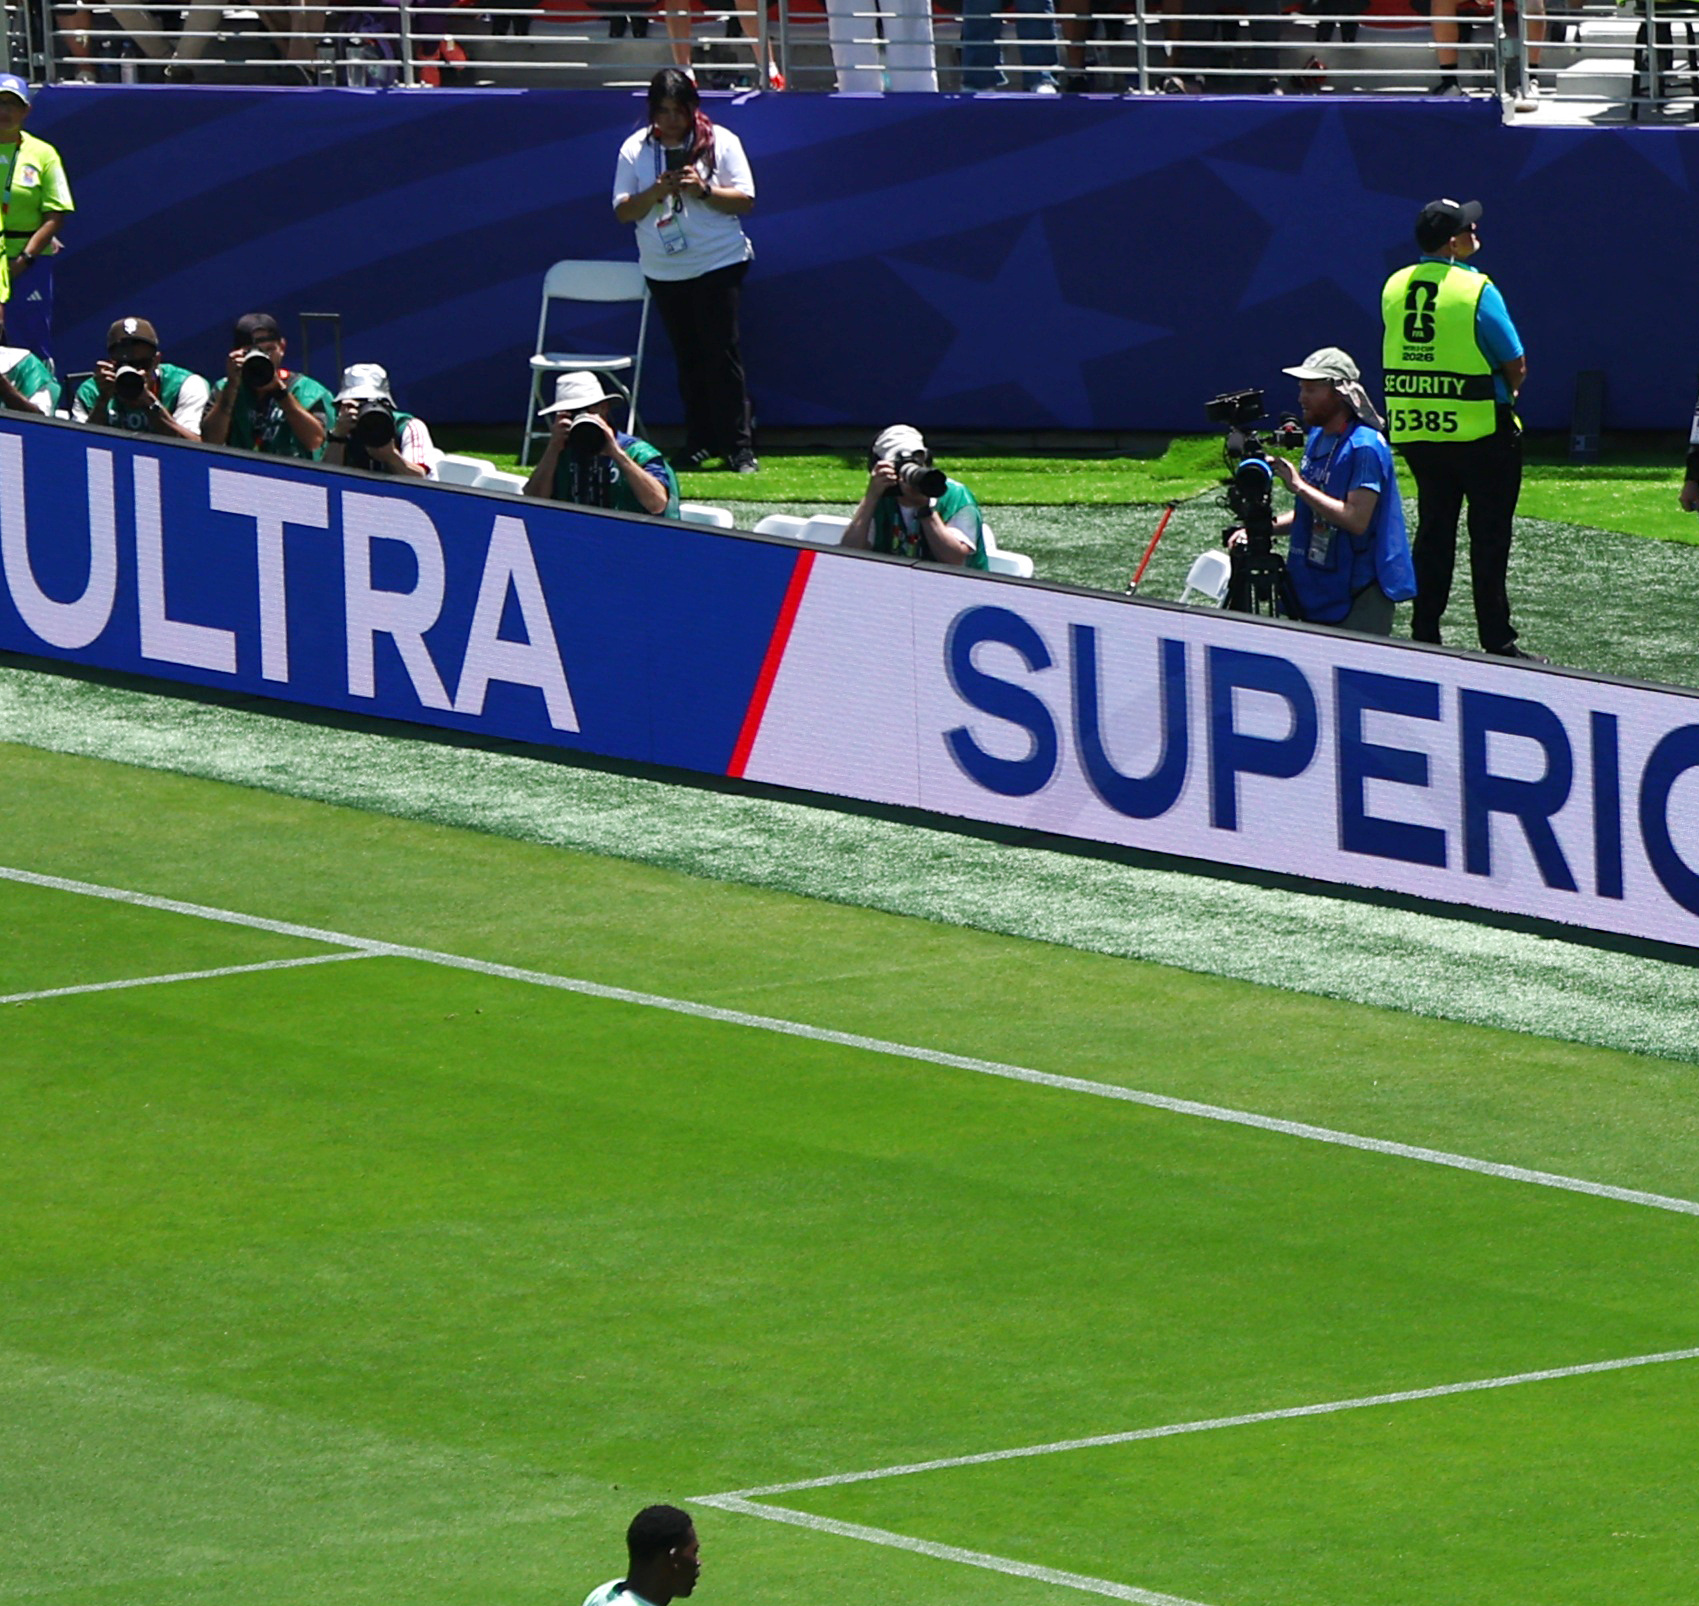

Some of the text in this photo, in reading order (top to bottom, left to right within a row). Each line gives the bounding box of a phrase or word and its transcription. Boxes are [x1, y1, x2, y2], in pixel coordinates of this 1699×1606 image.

[1401, 352, 1435, 362] 2026
[1384, 374, 1466, 396] SECURITY
[0, 432, 580, 734] ULTRA
